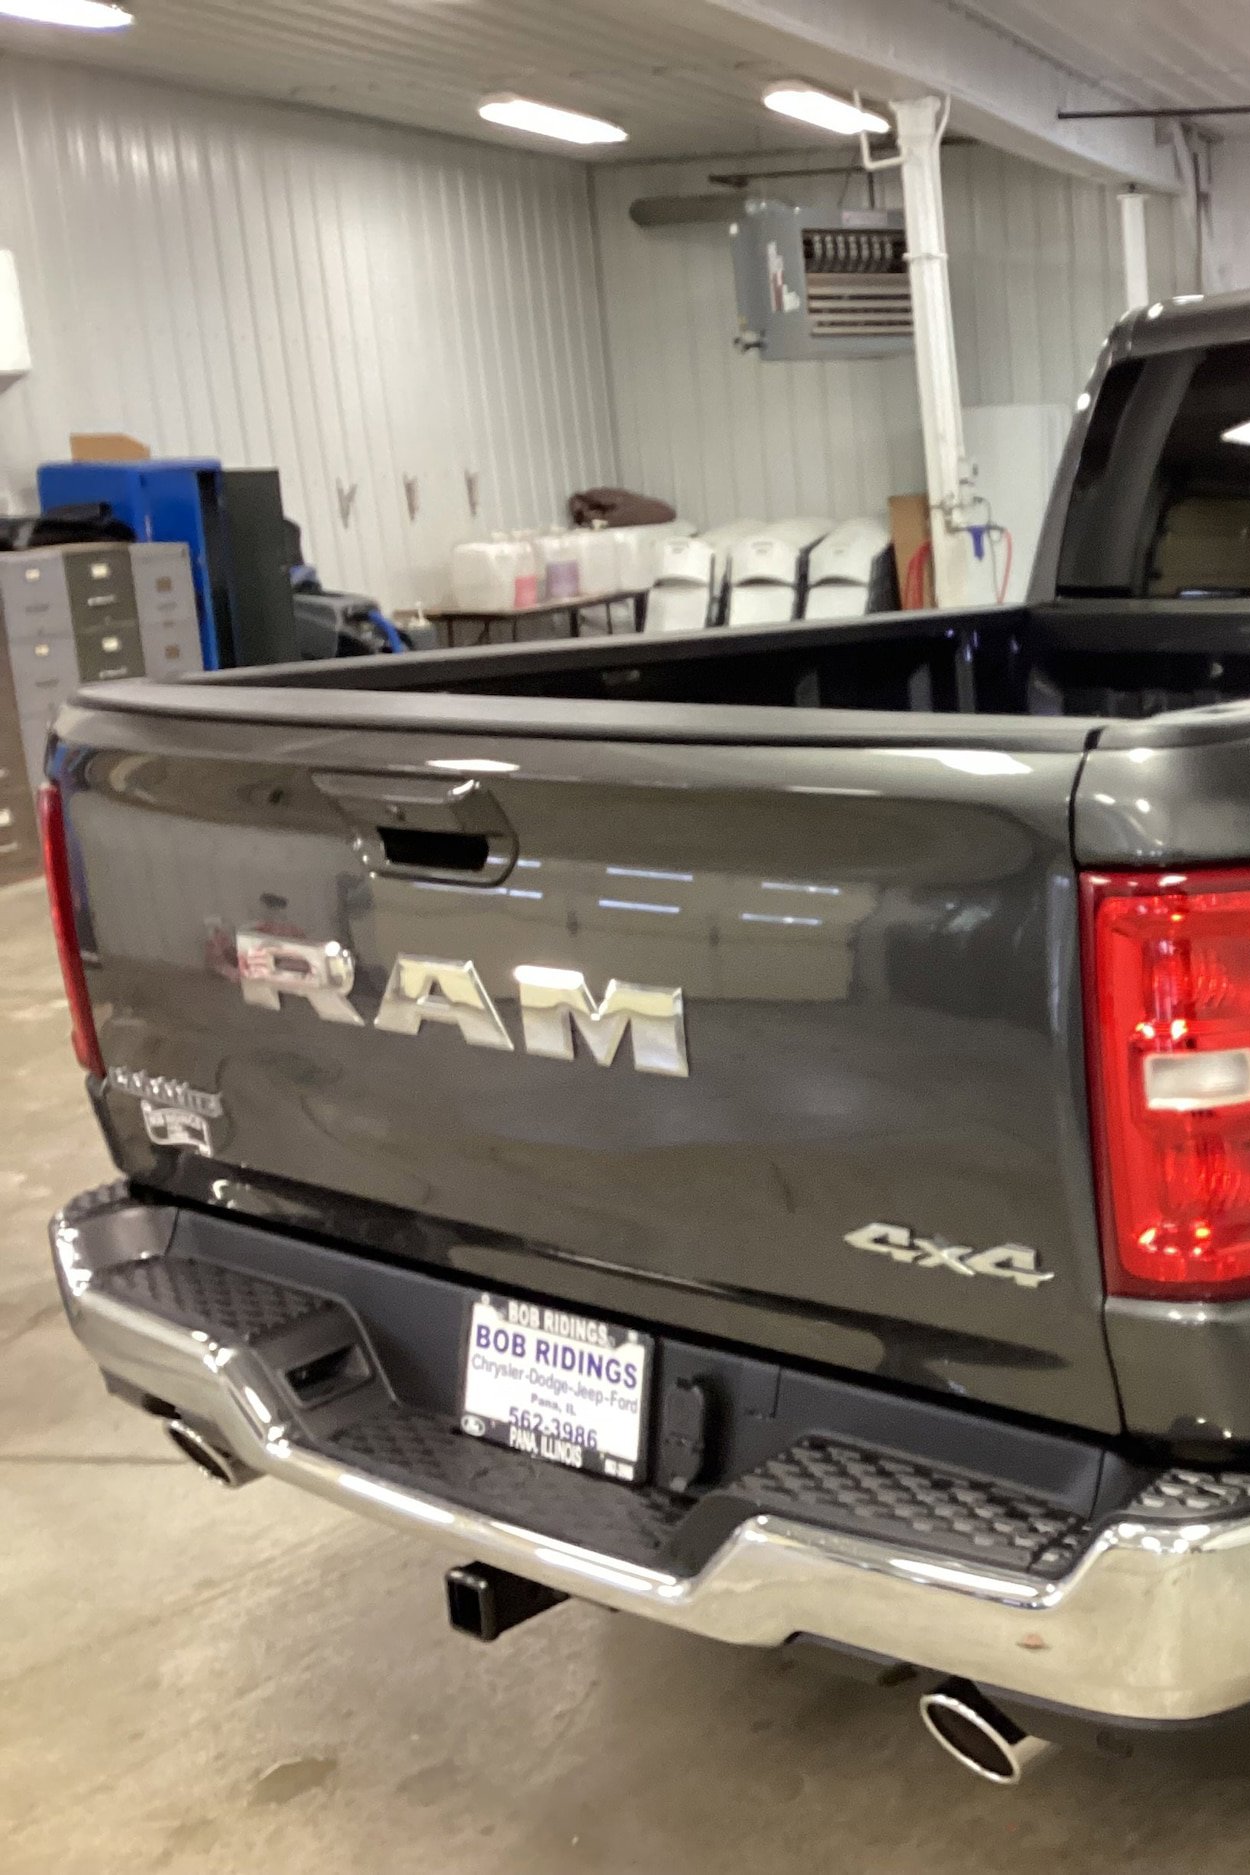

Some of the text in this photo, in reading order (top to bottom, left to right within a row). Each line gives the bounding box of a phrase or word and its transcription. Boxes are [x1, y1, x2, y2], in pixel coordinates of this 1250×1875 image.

[236, 930, 689, 1077] RAM
[508, 1301, 608, 1347] BOB RIDINGS
[476, 1324, 637, 1389] BOB RIDINGS
[471, 1353, 638, 1414] Chrysler-Dodge-Jeep-Ford
[509, 1406, 598, 1450] 562-3986
[540, 1434, 583, 1469] ILLINOIS
